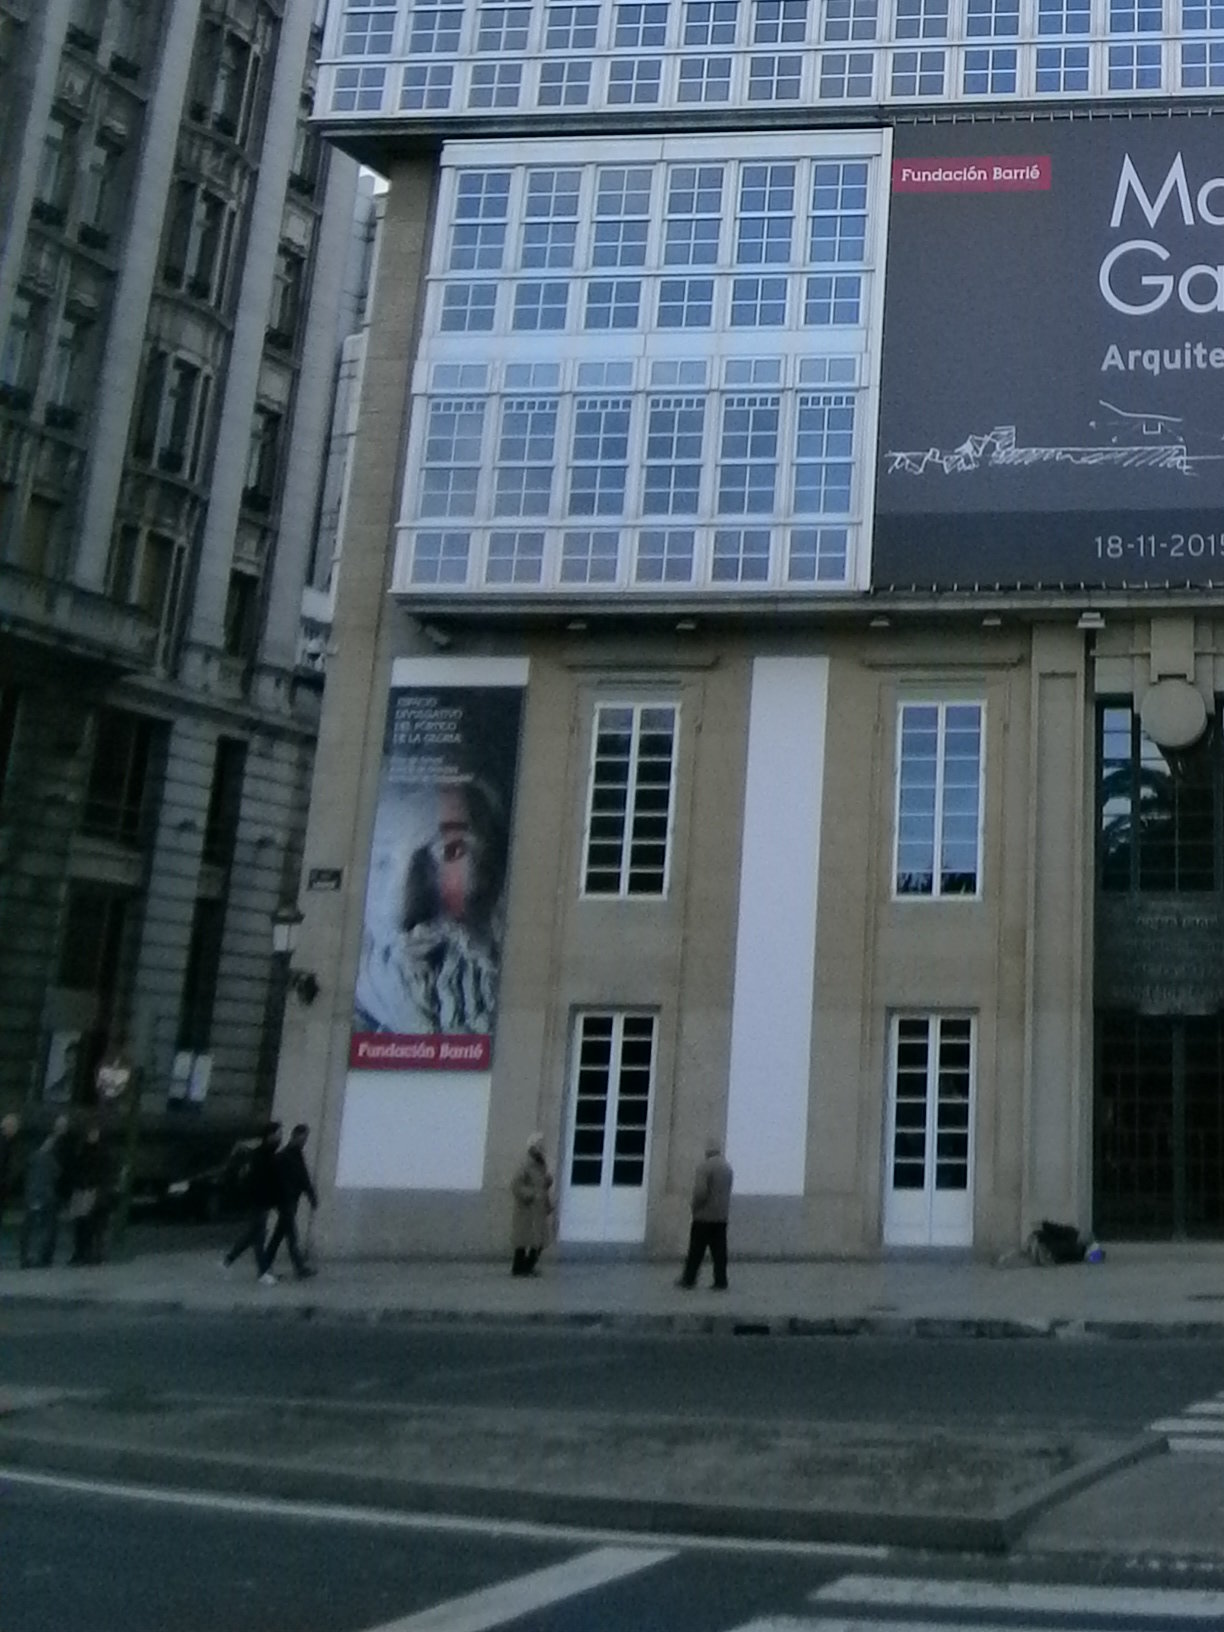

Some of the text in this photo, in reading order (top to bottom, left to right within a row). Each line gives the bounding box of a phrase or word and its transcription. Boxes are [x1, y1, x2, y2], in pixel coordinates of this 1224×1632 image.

[901, 164, 1041, 182] Fundación Barrié
[357, 1040, 435, 1059] Fundación
